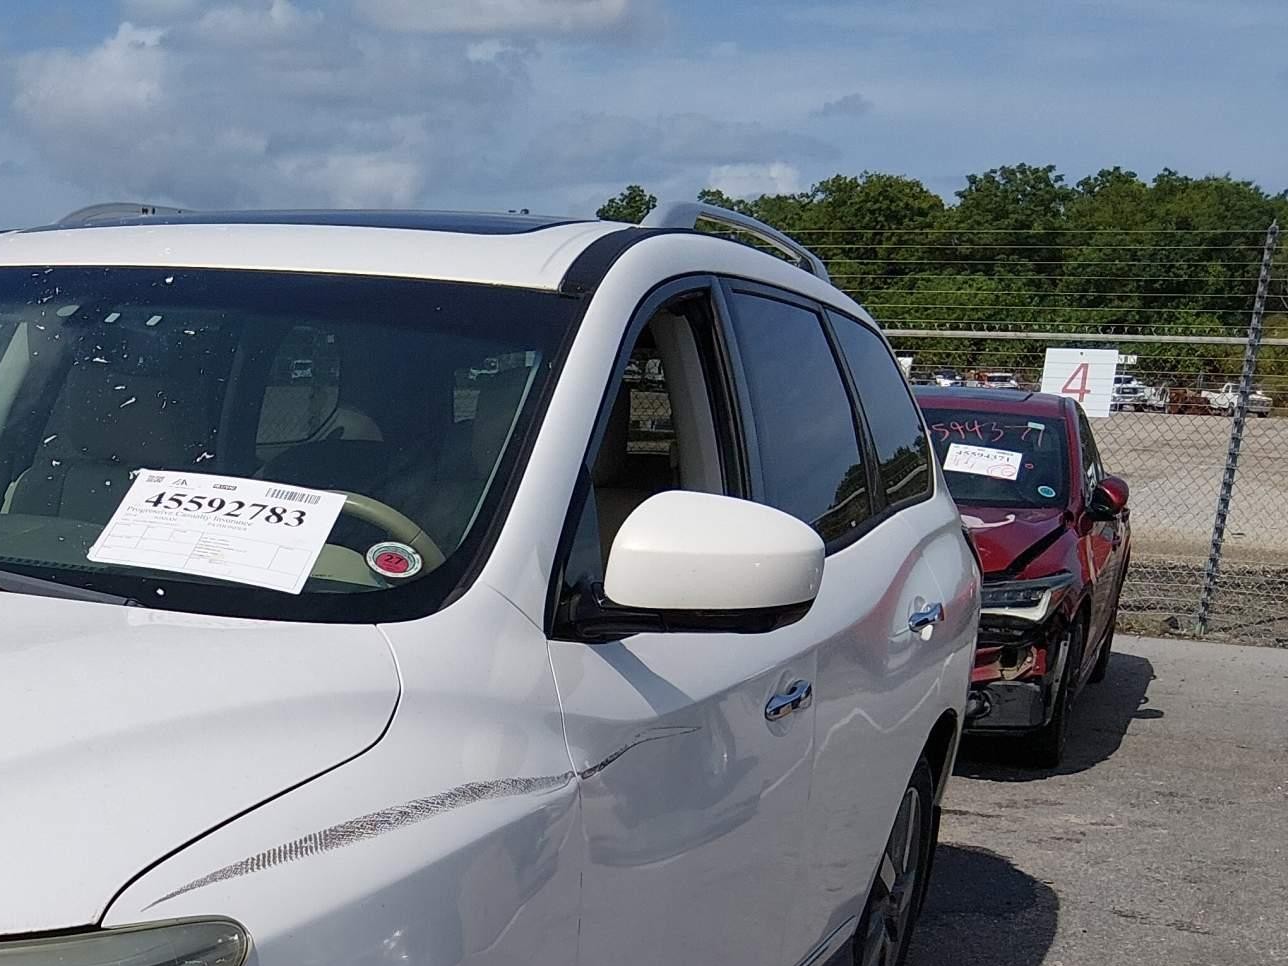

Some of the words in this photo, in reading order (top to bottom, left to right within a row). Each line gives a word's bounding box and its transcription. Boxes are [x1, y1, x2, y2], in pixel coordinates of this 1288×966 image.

[1061, 362, 1091, 402] 4
[144, 491, 307, 527] 45592783
[383, 554, 404, 565] 27
